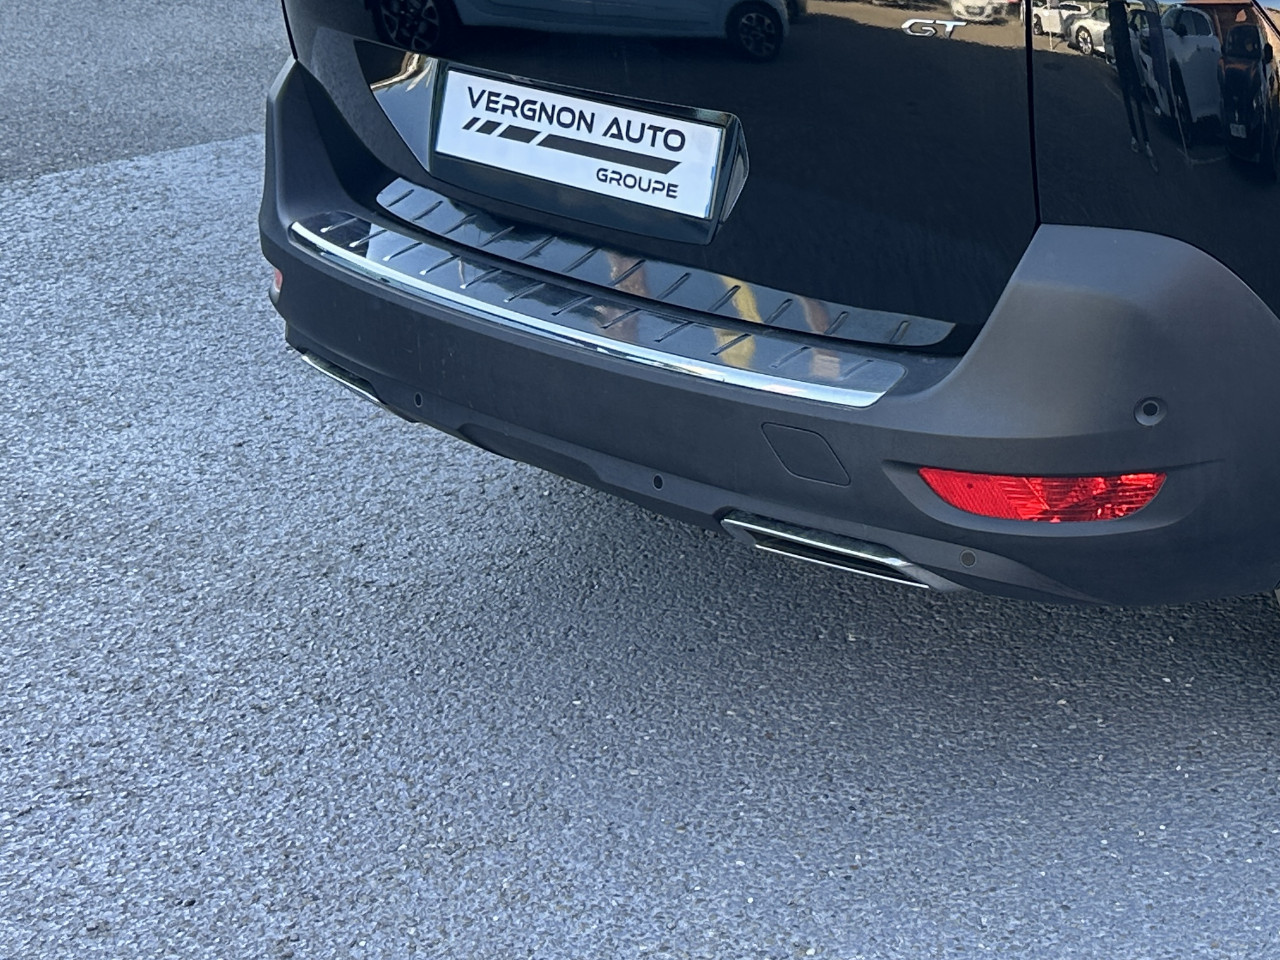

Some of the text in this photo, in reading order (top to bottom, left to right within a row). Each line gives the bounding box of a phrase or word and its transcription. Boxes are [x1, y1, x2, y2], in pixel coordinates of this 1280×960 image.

[901, 19, 967, 39] GT
[467, 86, 686, 152] VERGNON AUTO
[596, 167, 679, 199] GROUPE
